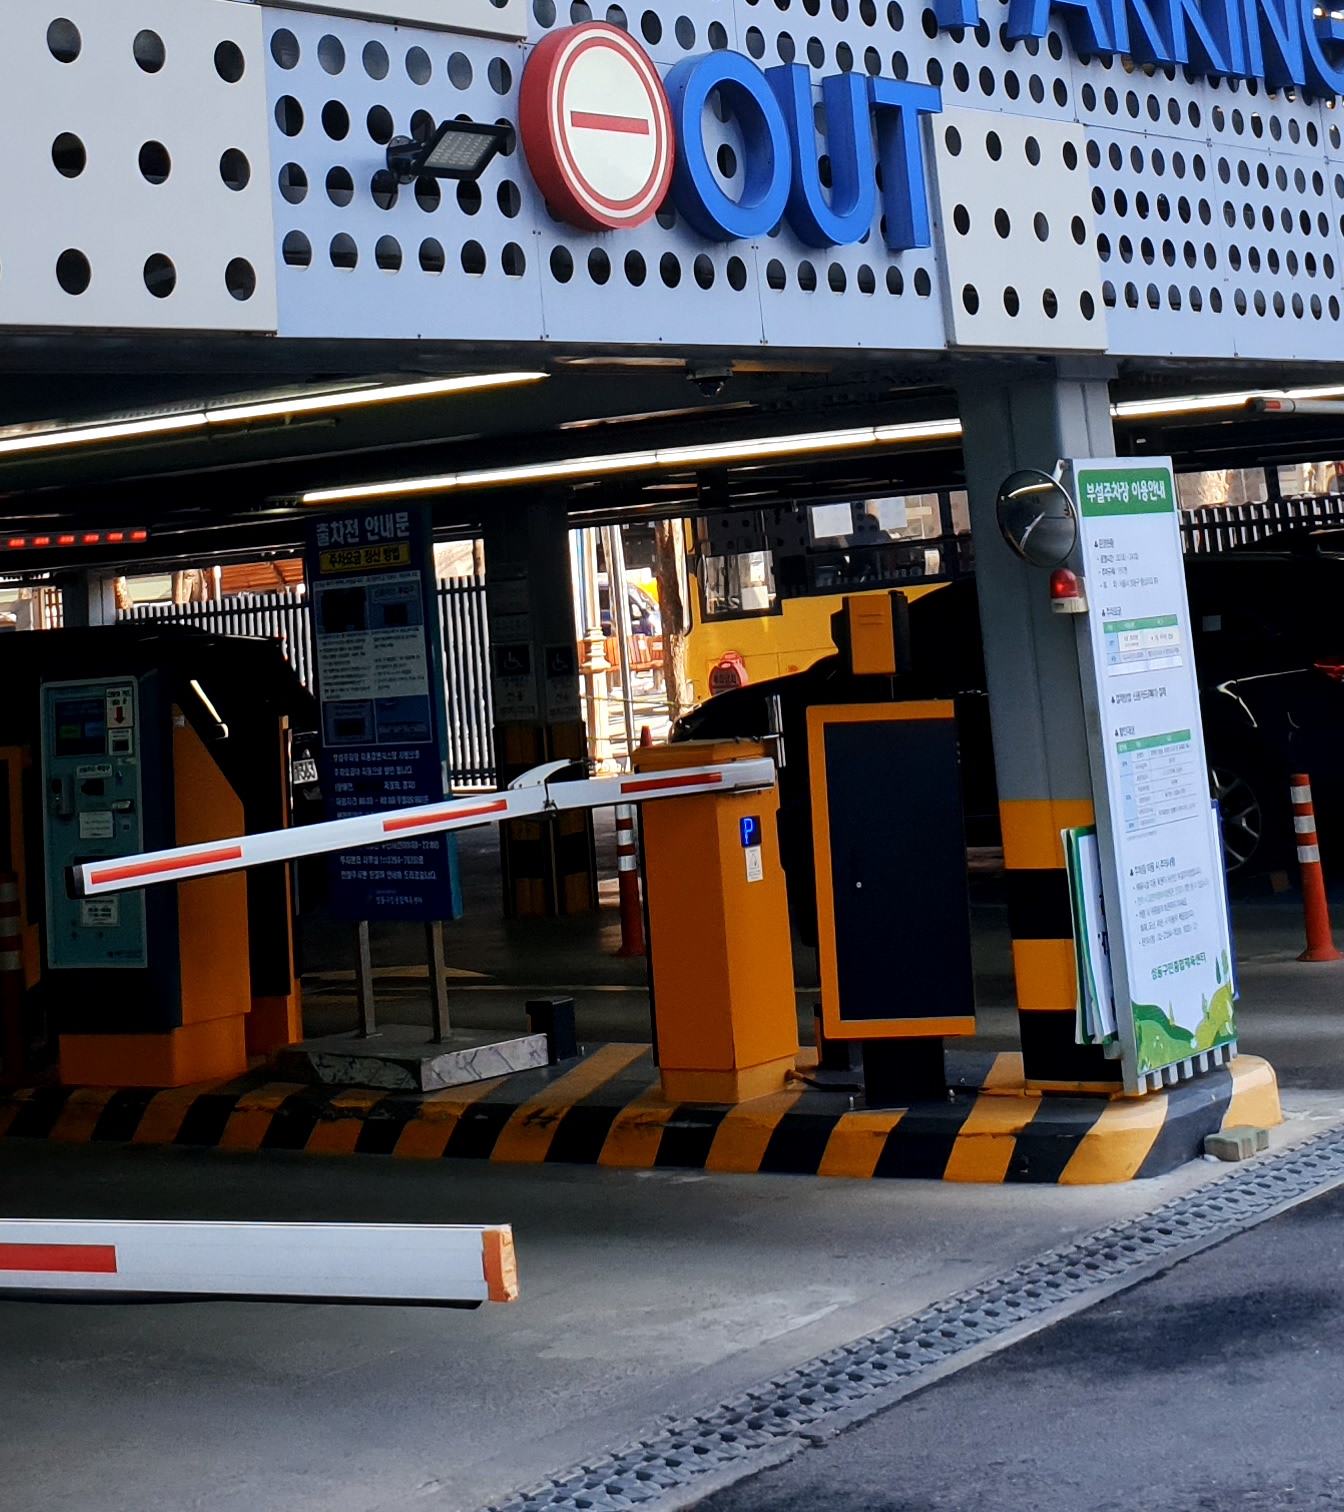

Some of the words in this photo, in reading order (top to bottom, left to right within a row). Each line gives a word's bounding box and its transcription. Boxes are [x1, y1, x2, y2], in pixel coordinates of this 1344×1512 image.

[664, 47, 943, 250] OUT
[1086, 481, 1129, 504] 부설주차장
[1131, 479, 1167, 503] 이용안내
[315, 517, 360, 548] 출차전
[364, 511, 411, 541] 안내문
[329, 551, 361, 568] 주차요금
[743, 817, 755, 846] P
